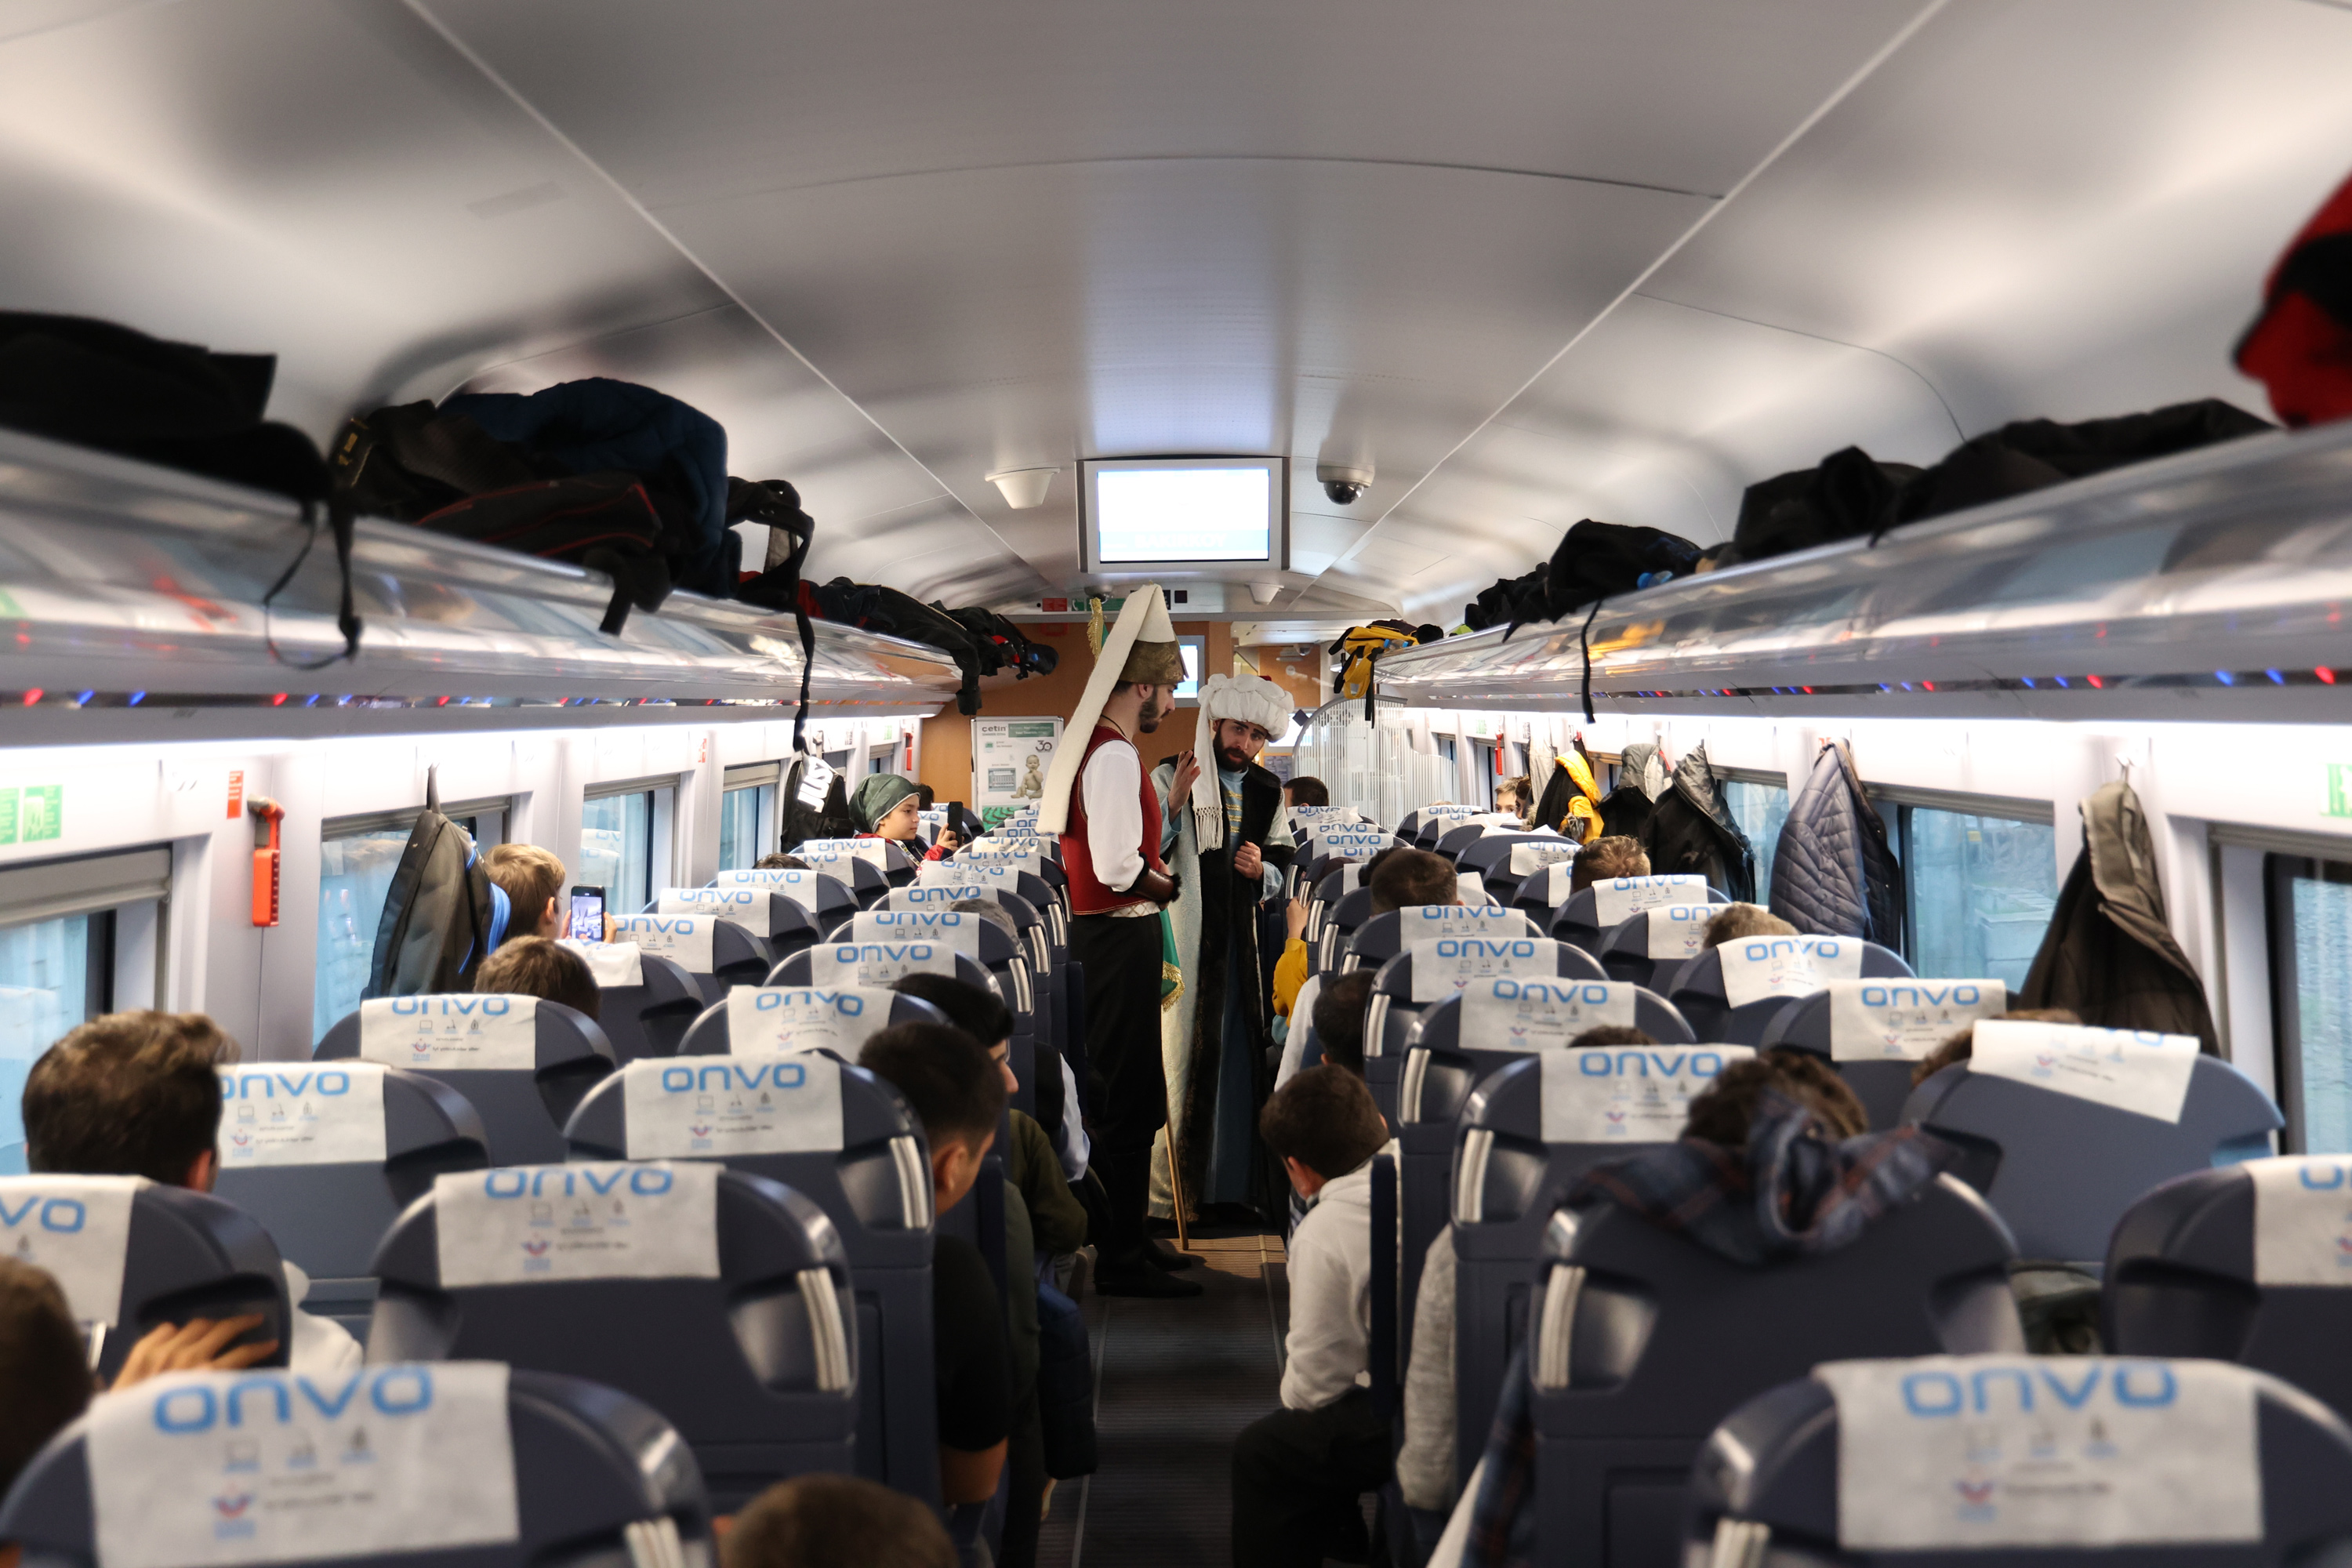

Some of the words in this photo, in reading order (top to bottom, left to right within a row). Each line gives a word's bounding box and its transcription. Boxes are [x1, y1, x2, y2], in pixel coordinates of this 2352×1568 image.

[818, 840, 872, 851] onvo
[988, 837, 1040, 847] onvo
[1327, 835, 1381, 844] onvo
[941, 861, 1004, 876] onvo
[735, 872, 800, 884] onvo
[1613, 875, 1687, 891] onvo
[680, 891, 753, 904] onvo
[909, 886, 981, 902] onvo
[876, 913, 961, 926] onvo
[1422, 906, 1506, 920] onvo
[836, 945, 932, 963] onvo
[1437, 940, 1534, 957] onvo
[1745, 938, 1839, 961] onvo
[1493, 979, 1607, 1004] onvo
[1861, 985, 1980, 1006] onvo
[392, 996, 510, 1016] onvo
[756, 990, 863, 1016] onvo
[1580, 1051, 1722, 1077] onvo
[662, 1063, 806, 1092] onvo
[484, 1167, 673, 1200] onvo
[1900, 1363, 2178, 1417] onvo
[152, 1365, 434, 1434] onvo
